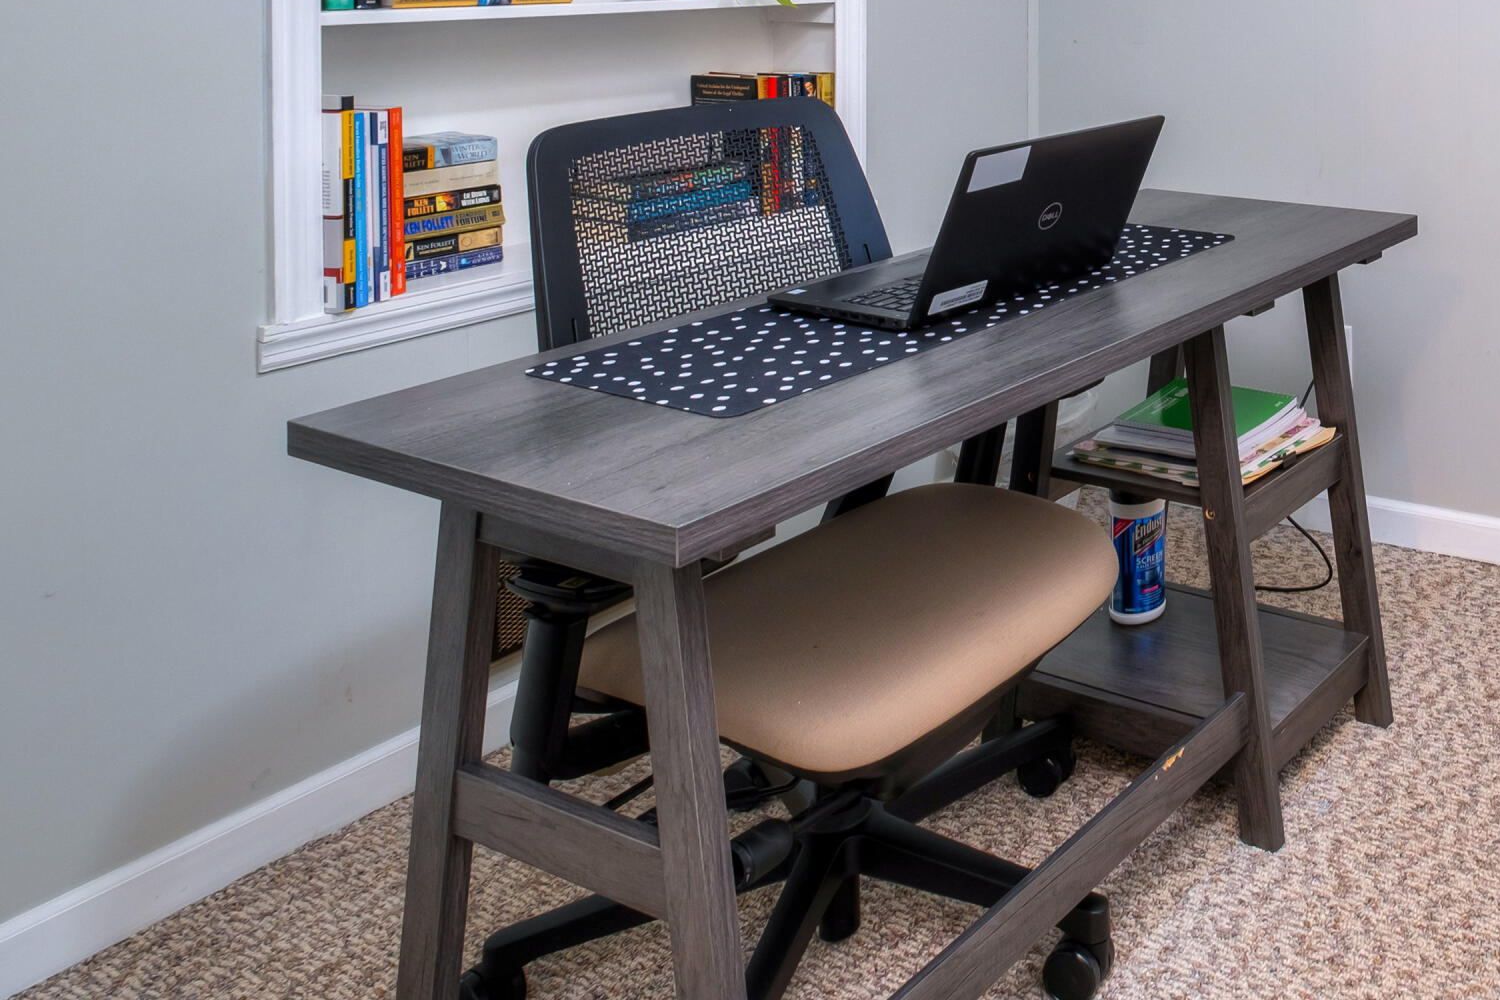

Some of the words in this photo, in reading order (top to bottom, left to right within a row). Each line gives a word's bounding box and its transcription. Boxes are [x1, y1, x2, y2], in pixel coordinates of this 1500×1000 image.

[404, 221, 421, 235] KEN
[422, 215, 454, 232] FOLLETT
[417, 243, 430, 251] KEN
[430, 239, 456, 248] FOLLETT
